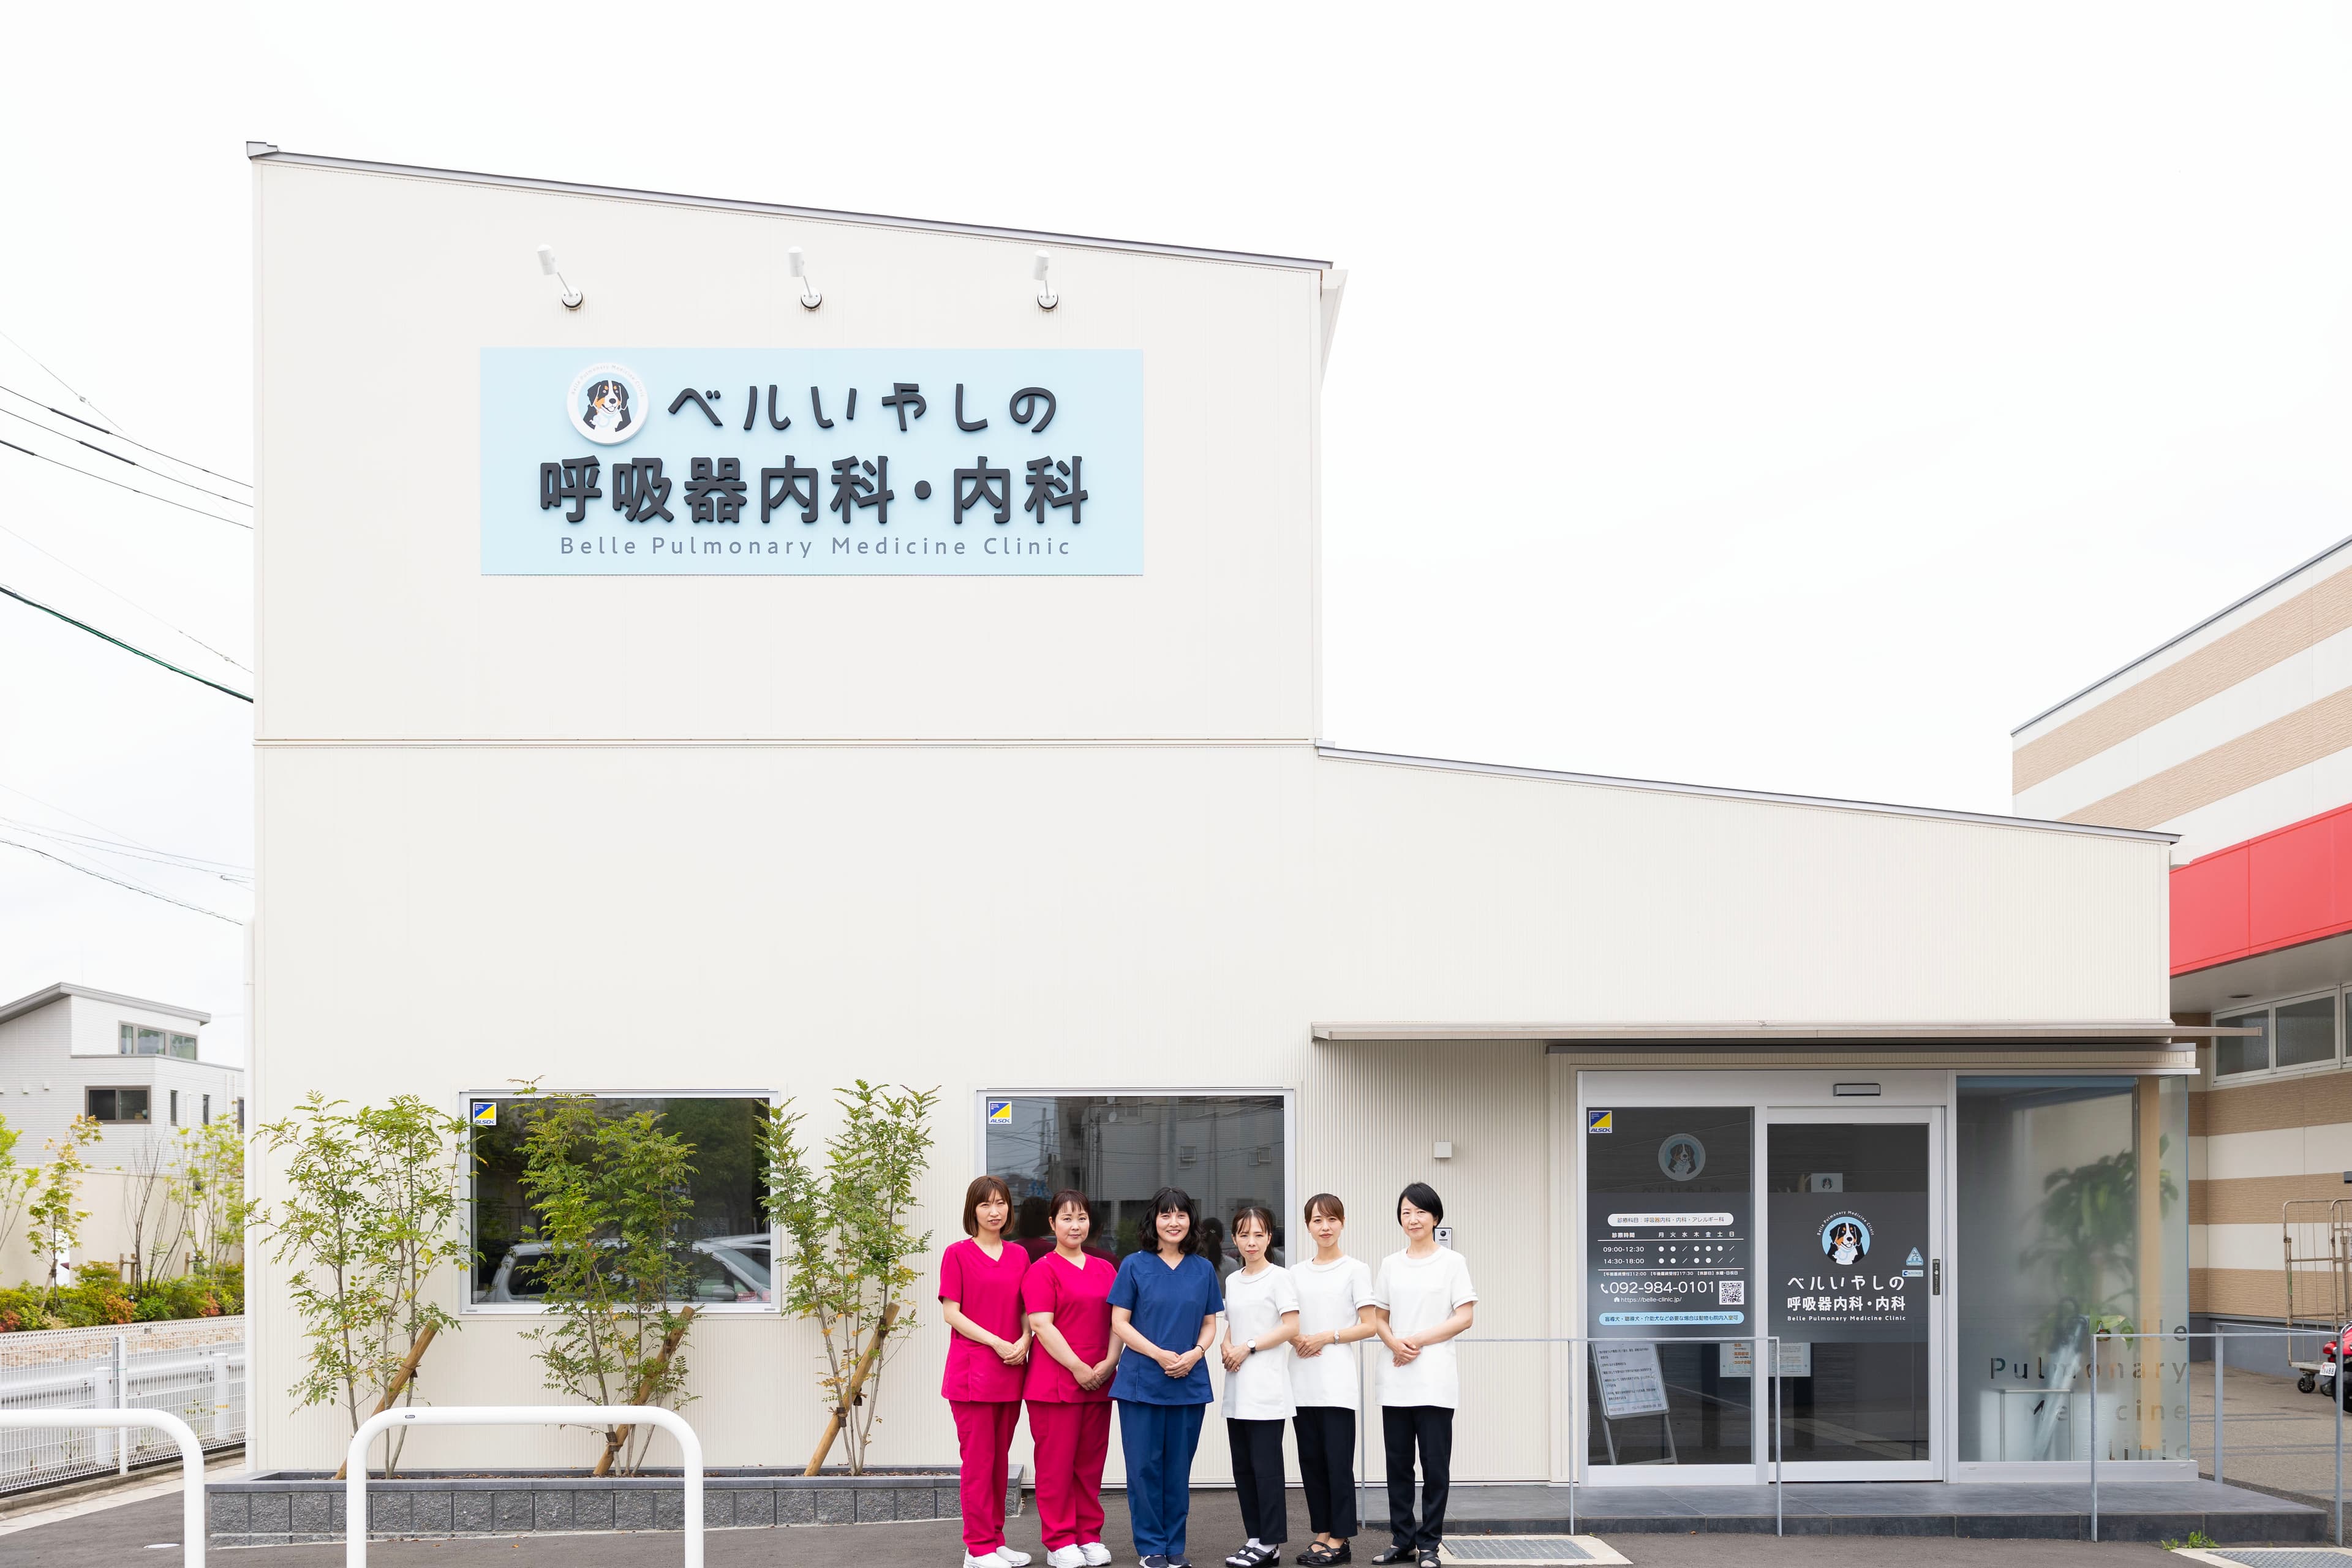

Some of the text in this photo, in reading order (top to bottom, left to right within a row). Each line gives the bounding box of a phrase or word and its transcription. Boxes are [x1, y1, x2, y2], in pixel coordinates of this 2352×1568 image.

[668, 382, 1057, 434] ベルいやしの
[540, 454, 1088, 525] 呼吸器内科・内科
[561, 536, 1069, 559] Belle Pulmonary Medicine Clinic
[1823, 1211, 1846, 1224] Pulmonary
[1847, 1210, 1867, 1223] Medicine
[1866, 1223, 1875, 1235] Clinic
[1610, 1281, 1714, 1294] 092-984-0101
[1787, 1275, 1905, 1291] ベルいやしの
[1787, 1295, 1905, 1311] 呼吸器内科・内科
